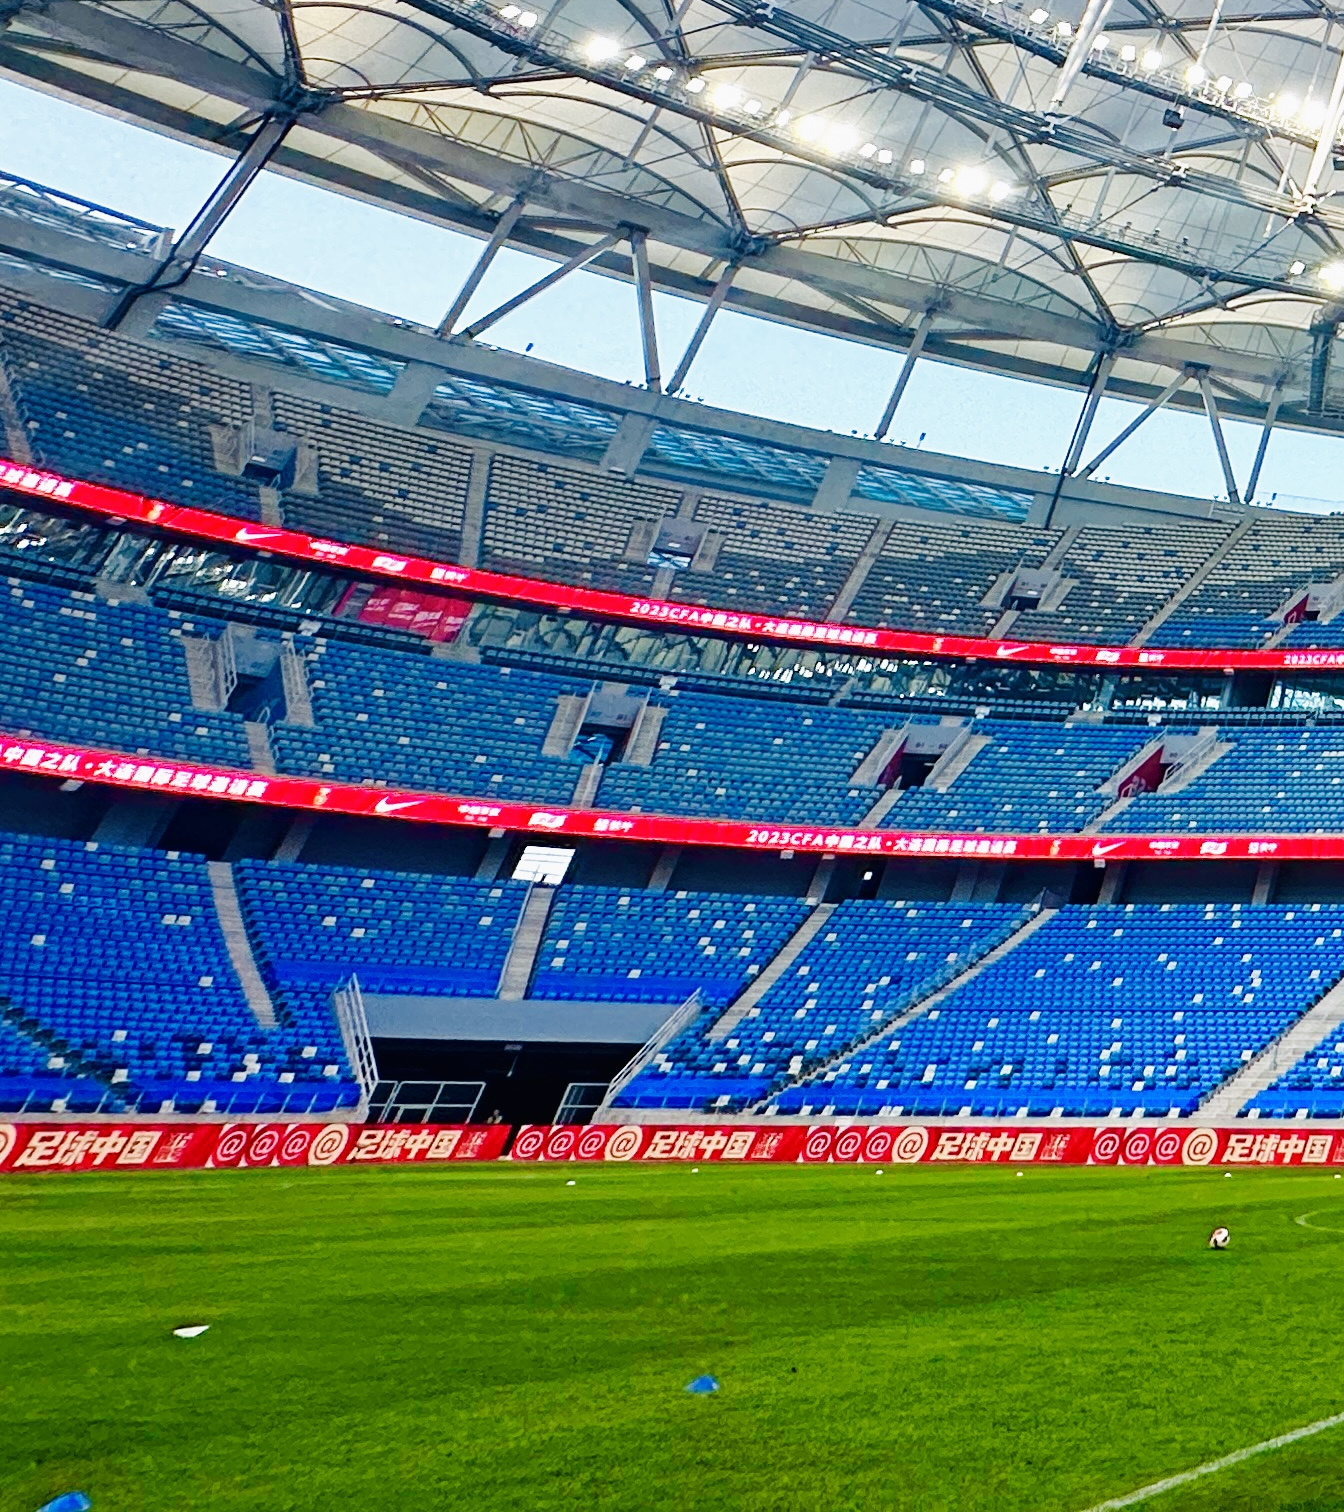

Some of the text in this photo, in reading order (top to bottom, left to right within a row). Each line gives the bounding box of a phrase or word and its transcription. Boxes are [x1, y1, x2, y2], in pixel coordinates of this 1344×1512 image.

[13, 1130, 161, 1167] 足球中国
[216, 1130, 247, 1161] @
[249, 1130, 279, 1161] @
[282, 1130, 310, 1160] @
[349, 1129, 462, 1161] 足球中国
[516, 1130, 544, 1158] @
[547, 1130, 575, 1158] @
[578, 1130, 606, 1158] @
[644, 1130, 755, 1160] 足球中国
[806, 1131, 832, 1159] @
[836, 1131, 862, 1159] @
[865, 1131, 891, 1159] @
[931, 1131, 1042, 1161] 足球中国
[1094, 1133, 1120, 1161] @
[1125, 1133, 1151, 1161] @
[1155, 1133, 1181, 1161] @
[1222, 1133, 1333, 1163] 足球中国
